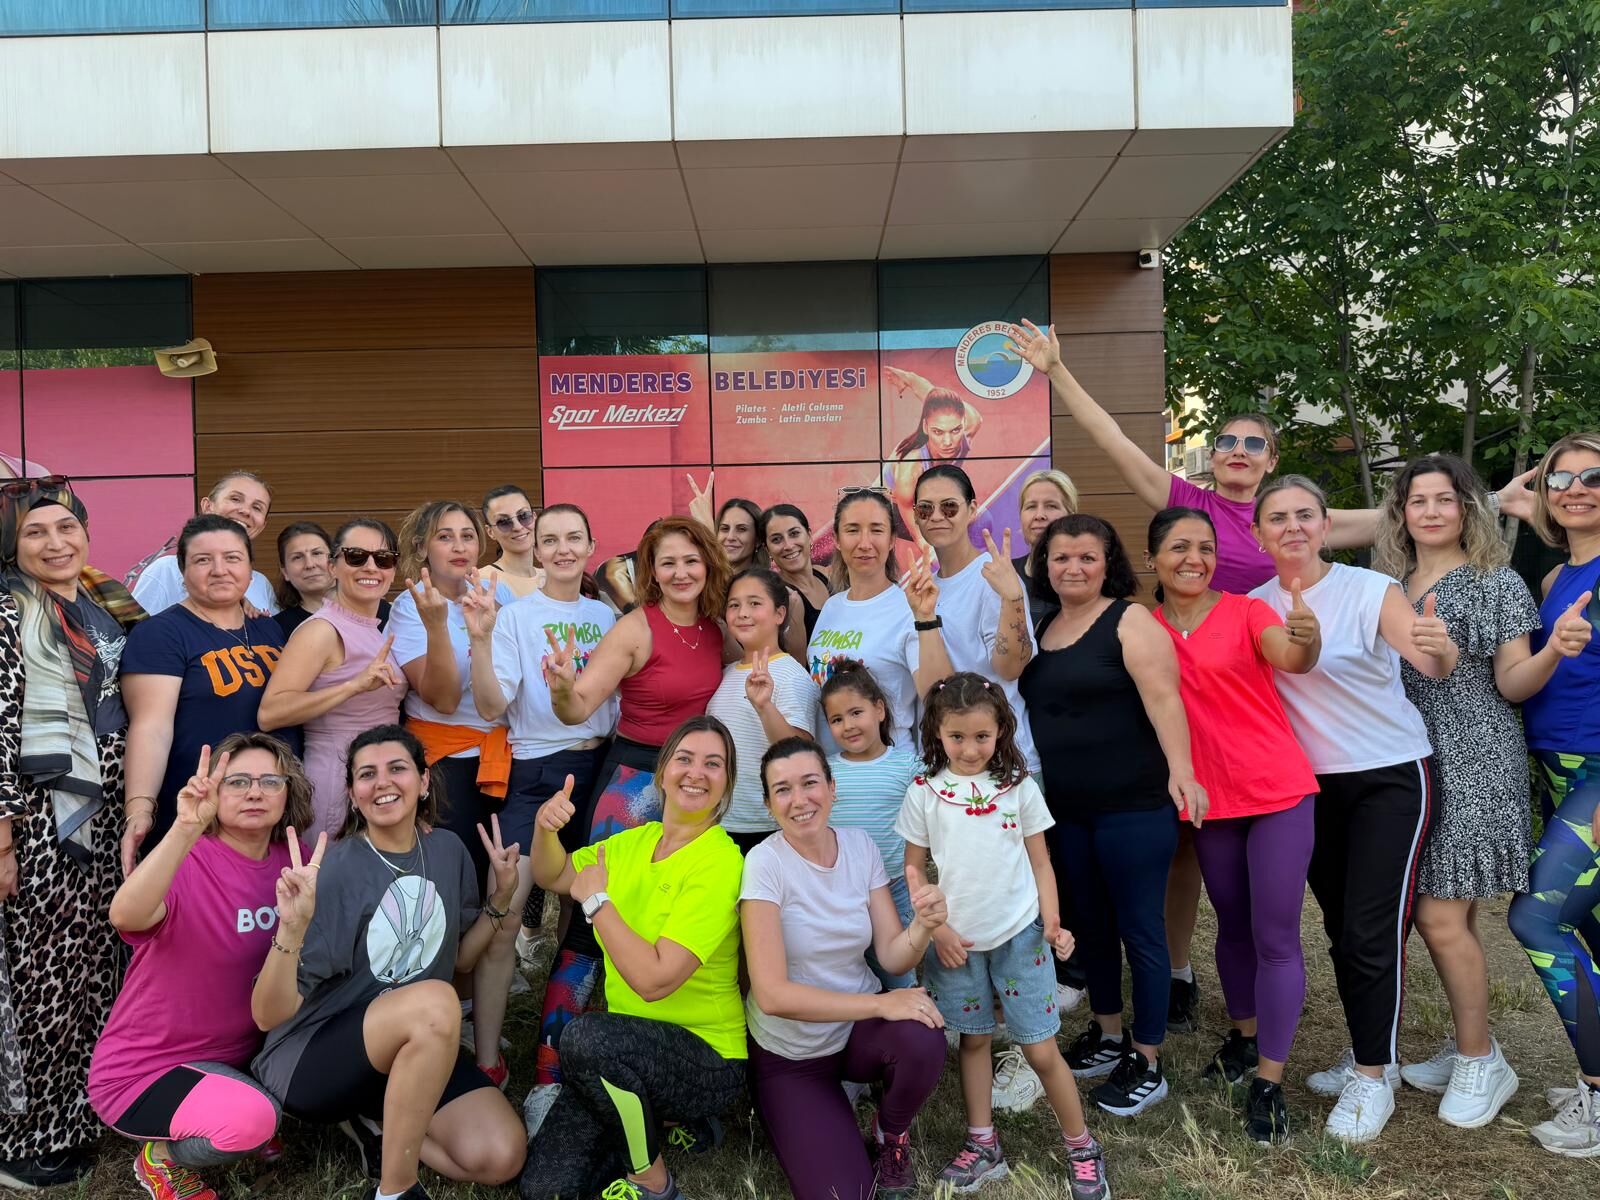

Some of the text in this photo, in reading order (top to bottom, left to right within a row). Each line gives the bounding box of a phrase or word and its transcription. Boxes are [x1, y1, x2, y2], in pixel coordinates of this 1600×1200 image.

[957, 324, 992, 367] MENDERES
[550, 371, 693, 395] MENDERES
[986, 388, 1006, 397] 1952
[548, 404, 688, 430] Spor Merkezi
[735, 404, 767, 413] Pilates
[781, 403, 806, 412] Aletli
[736, 415, 767, 424] Zumba
[779, 414, 801, 424] Latin
[542, 621, 603, 645] ZUMBA
[810, 628, 863, 650] ZUMBA
[200, 644, 284, 697] USP
[237, 906, 281, 933] BO
